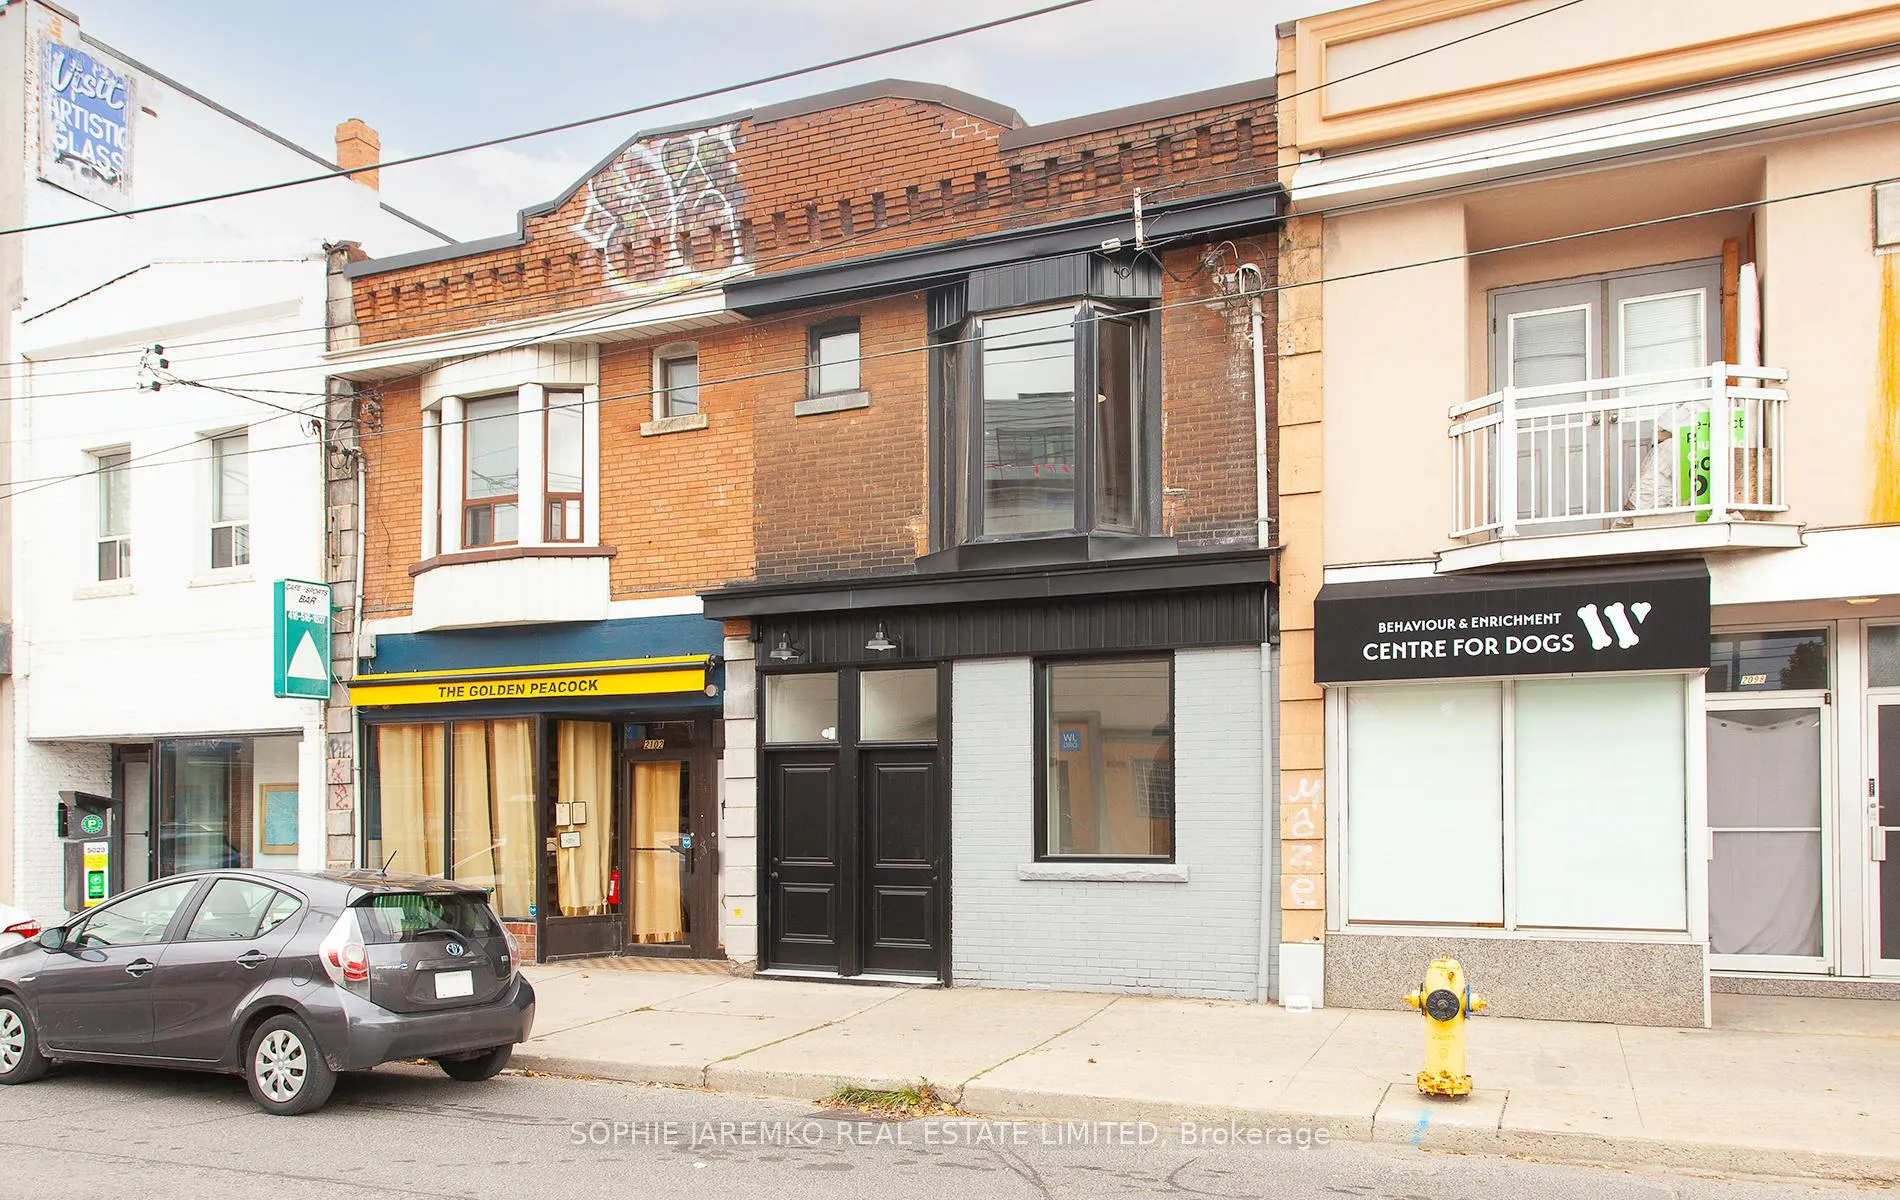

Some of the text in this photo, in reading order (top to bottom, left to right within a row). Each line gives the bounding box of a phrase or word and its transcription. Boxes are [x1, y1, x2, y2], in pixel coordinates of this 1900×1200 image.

[51, 52, 125, 110] Visit
[298, 595, 317, 604] BAR
[305, 588, 328, 596] SPORTS
[1378, 612, 1562, 634] BEHAVIOUR & ENRICHMENT
[1362, 633, 1575, 661] CENTRE FOR DOGS
[438, 679, 599, 698] THE GOLDEN PEACOCK
[644, 740, 664, 749] 2102
